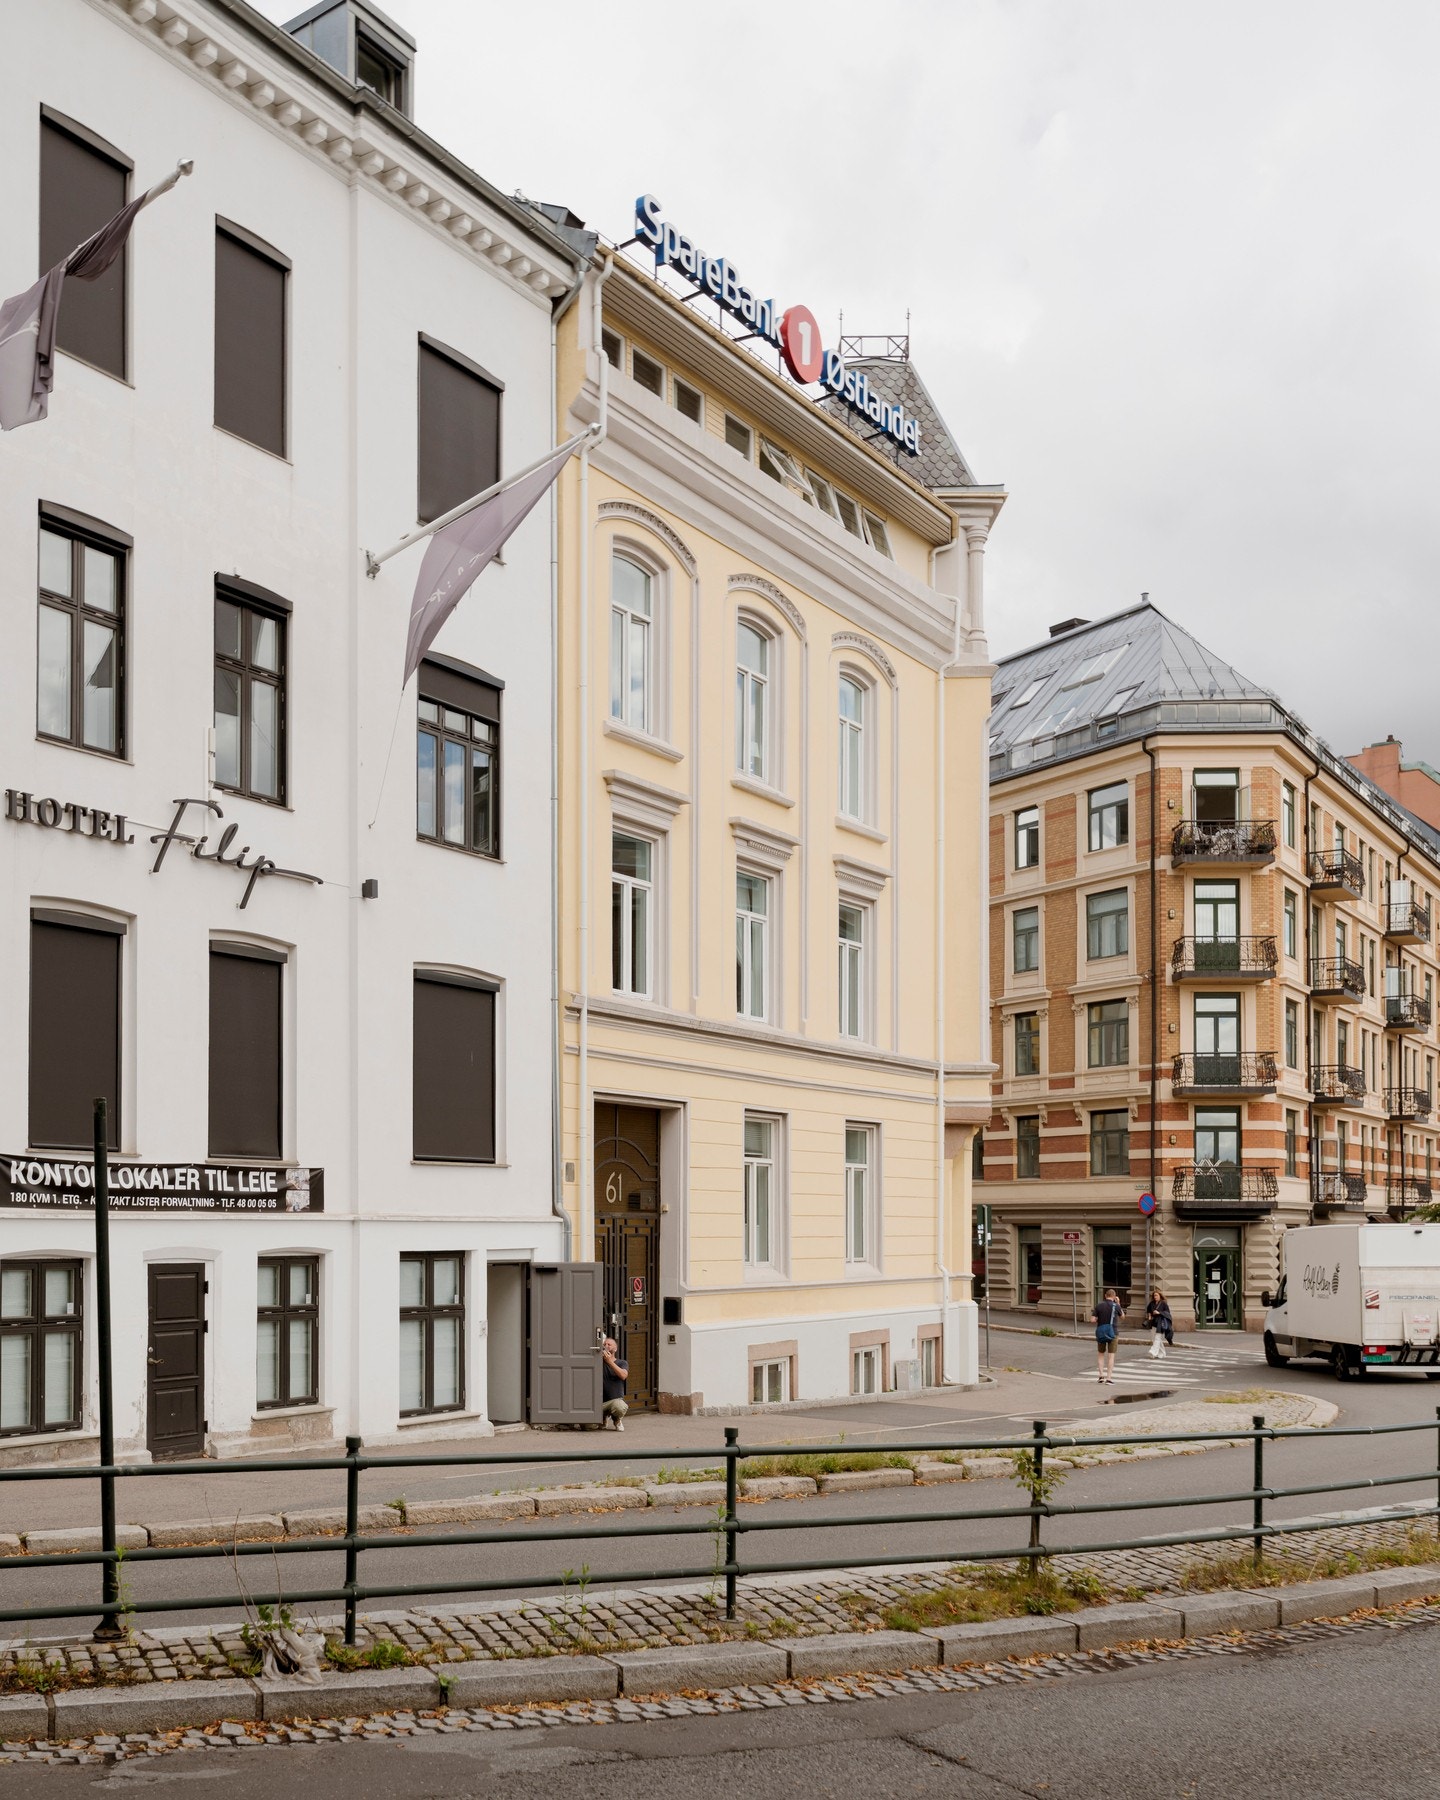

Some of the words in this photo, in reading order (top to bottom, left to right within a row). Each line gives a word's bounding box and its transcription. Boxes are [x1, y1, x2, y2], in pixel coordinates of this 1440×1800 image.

[635, 194, 784, 348] SpareBank
[820, 349, 922, 457] Østlandet
[5, 788, 135, 844] HOTEL
[150, 799, 324, 909] Filip
[205, 1169, 234, 1192] TIL
[238, 1171, 278, 1193] LEIE
[605, 1171, 623, 1204] 61
[10, 1192, 28, 1203] 180
[29, 1193, 51, 1204] KVM
[52, 1194, 61, 1204] 1.
[62, 1194, 82, 1205] ETG.
[90, 1195, 130, 1206] KTAKT
[131, 1196, 160, 1207] LISTER
[161, 1197, 215, 1207] FORVALTNING
[221, 1198, 235, 1208] TLF.
[236, 1198, 246, 1208] 48
[247, 1198, 257, 1208] 00
[257, 1198, 267, 1208] 05
[267, 1198, 277, 1208] 05
